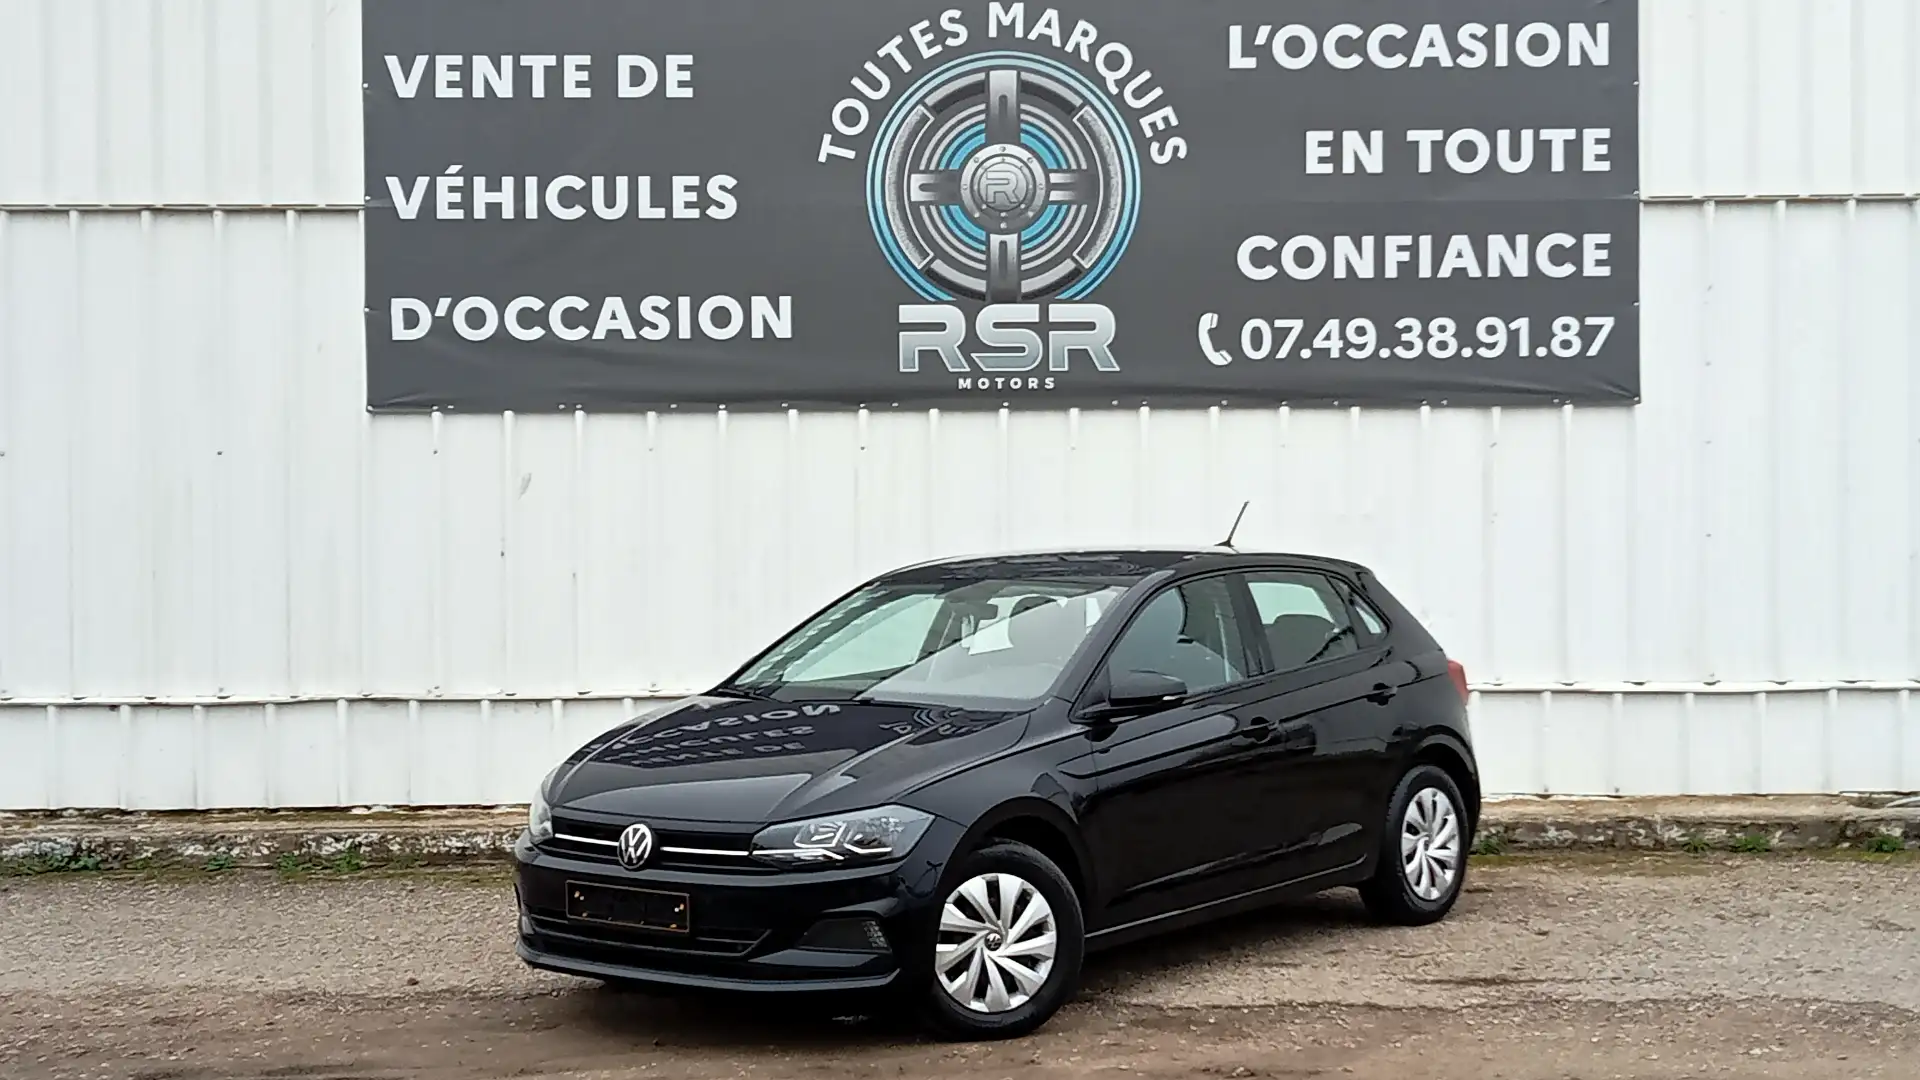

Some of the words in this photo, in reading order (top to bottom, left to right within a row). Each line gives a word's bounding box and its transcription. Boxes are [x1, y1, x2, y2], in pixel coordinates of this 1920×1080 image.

[383, 54, 592, 99] VENTE
[617, 54, 694, 98] DE
[817, 9, 969, 164] TOUTES
[987, 1, 1188, 166] MARQUES
[1305, 129, 1384, 174] EN
[1406, 127, 1611, 174] TOUTE
[385, 164, 738, 220] VÉHICULES
[1236, 232, 1612, 281] CONFIANCE
[898, 303, 1121, 373] RSR
[1240, 315, 1615, 360] 07.49.38.91.87
[957, 377, 1056, 390] MOTORS
